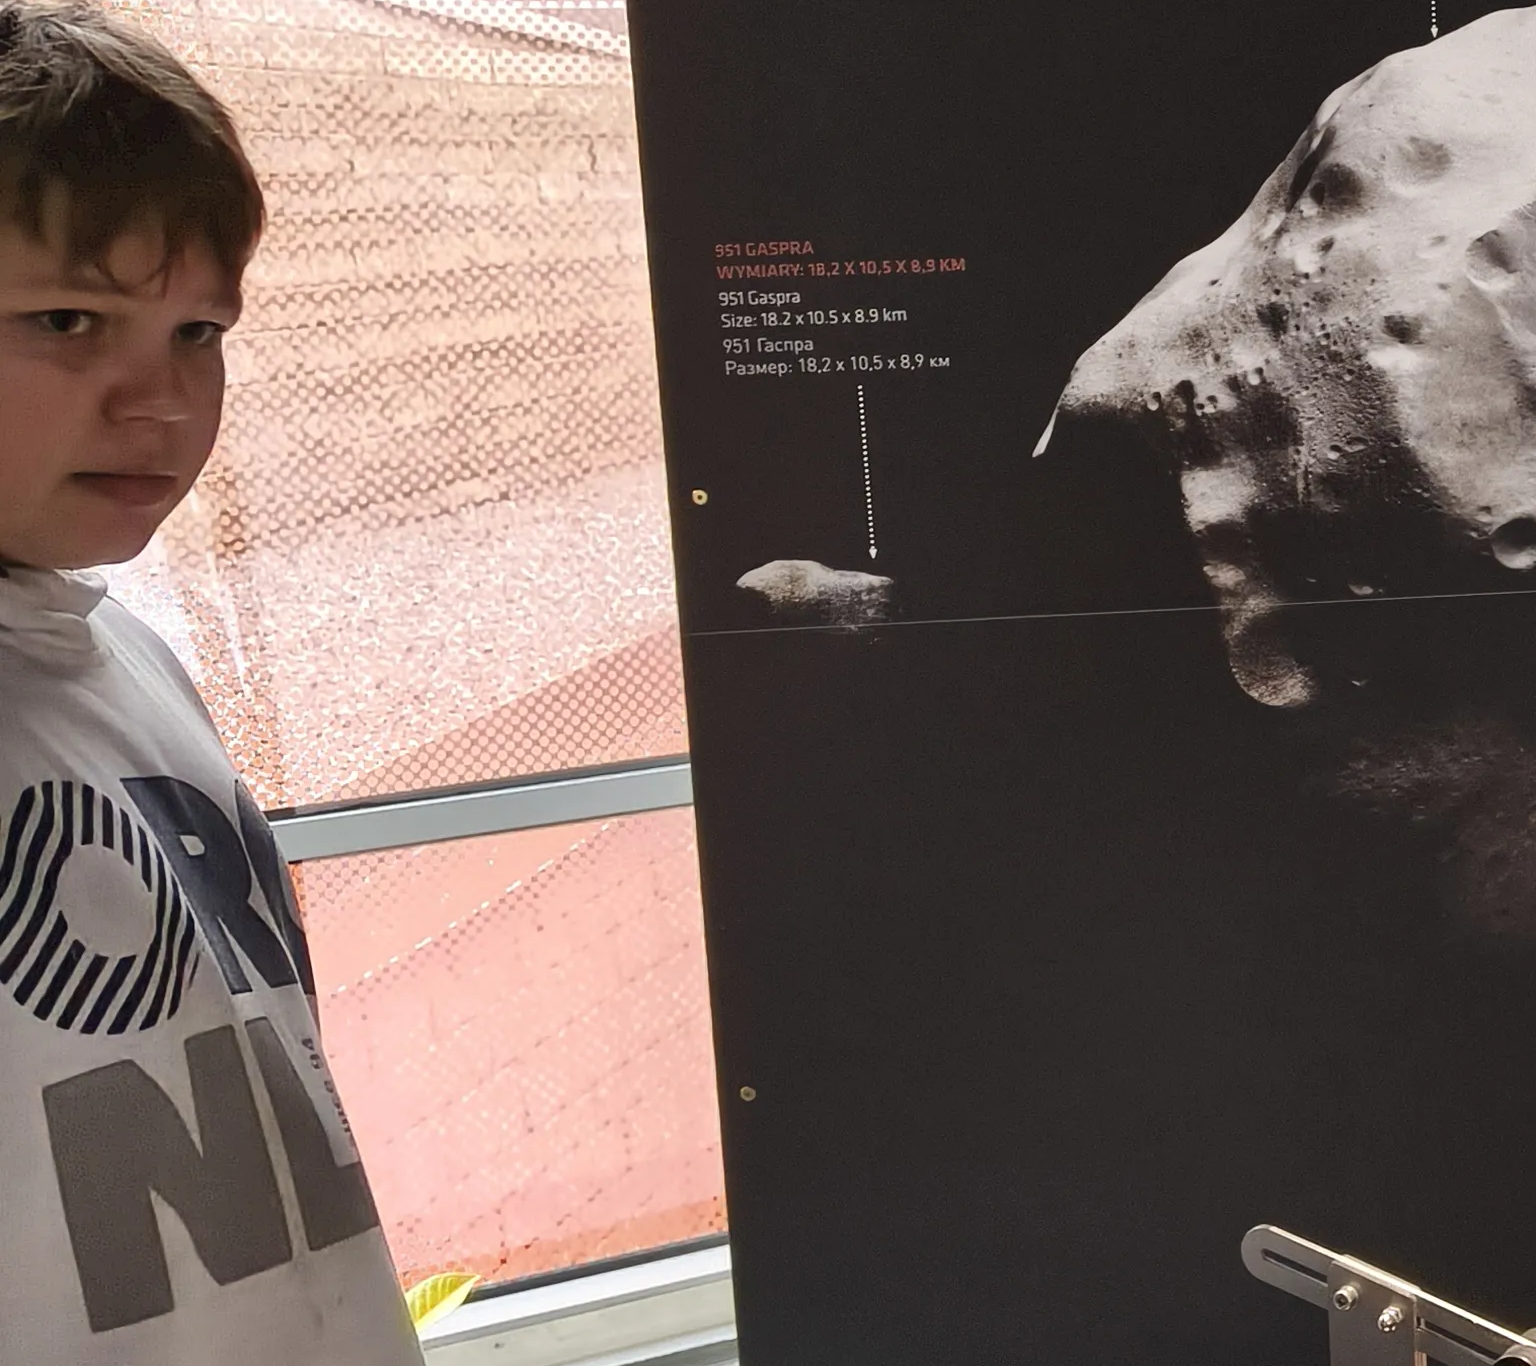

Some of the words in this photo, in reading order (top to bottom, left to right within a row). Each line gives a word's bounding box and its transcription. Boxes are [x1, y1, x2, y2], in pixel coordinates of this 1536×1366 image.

[715, 244, 741, 258] 951
[745, 241, 814, 257] GASPRA
[716, 263, 805, 280] WYMIARY:
[808, 262, 840, 278] 18,2
[845, 260, 855, 275] X
[859, 260, 891, 275] 10,5
[895, 259, 907, 274] X
[939, 258, 965, 272] KM
[718, 292, 744, 306] 951
[747, 290, 801, 307] Gaspra
[720, 313, 758, 328] Size:
[760, 312, 792, 327] 18.2
[795, 314, 804, 326] x
[806, 311, 839, 326] 10.5
[842, 313, 851, 324] x
[854, 309, 879, 324] 8.9
[882, 307, 908, 322] km
[722, 339, 751, 354] 951
[757, 336, 814, 356] Гаспра
[724, 360, 793, 378] Размер:
[798, 357, 831, 374] 18,2
[851, 356, 884, 372] 10,5
[900, 354, 924, 371] 8,9
[929, 356, 951, 369] км
